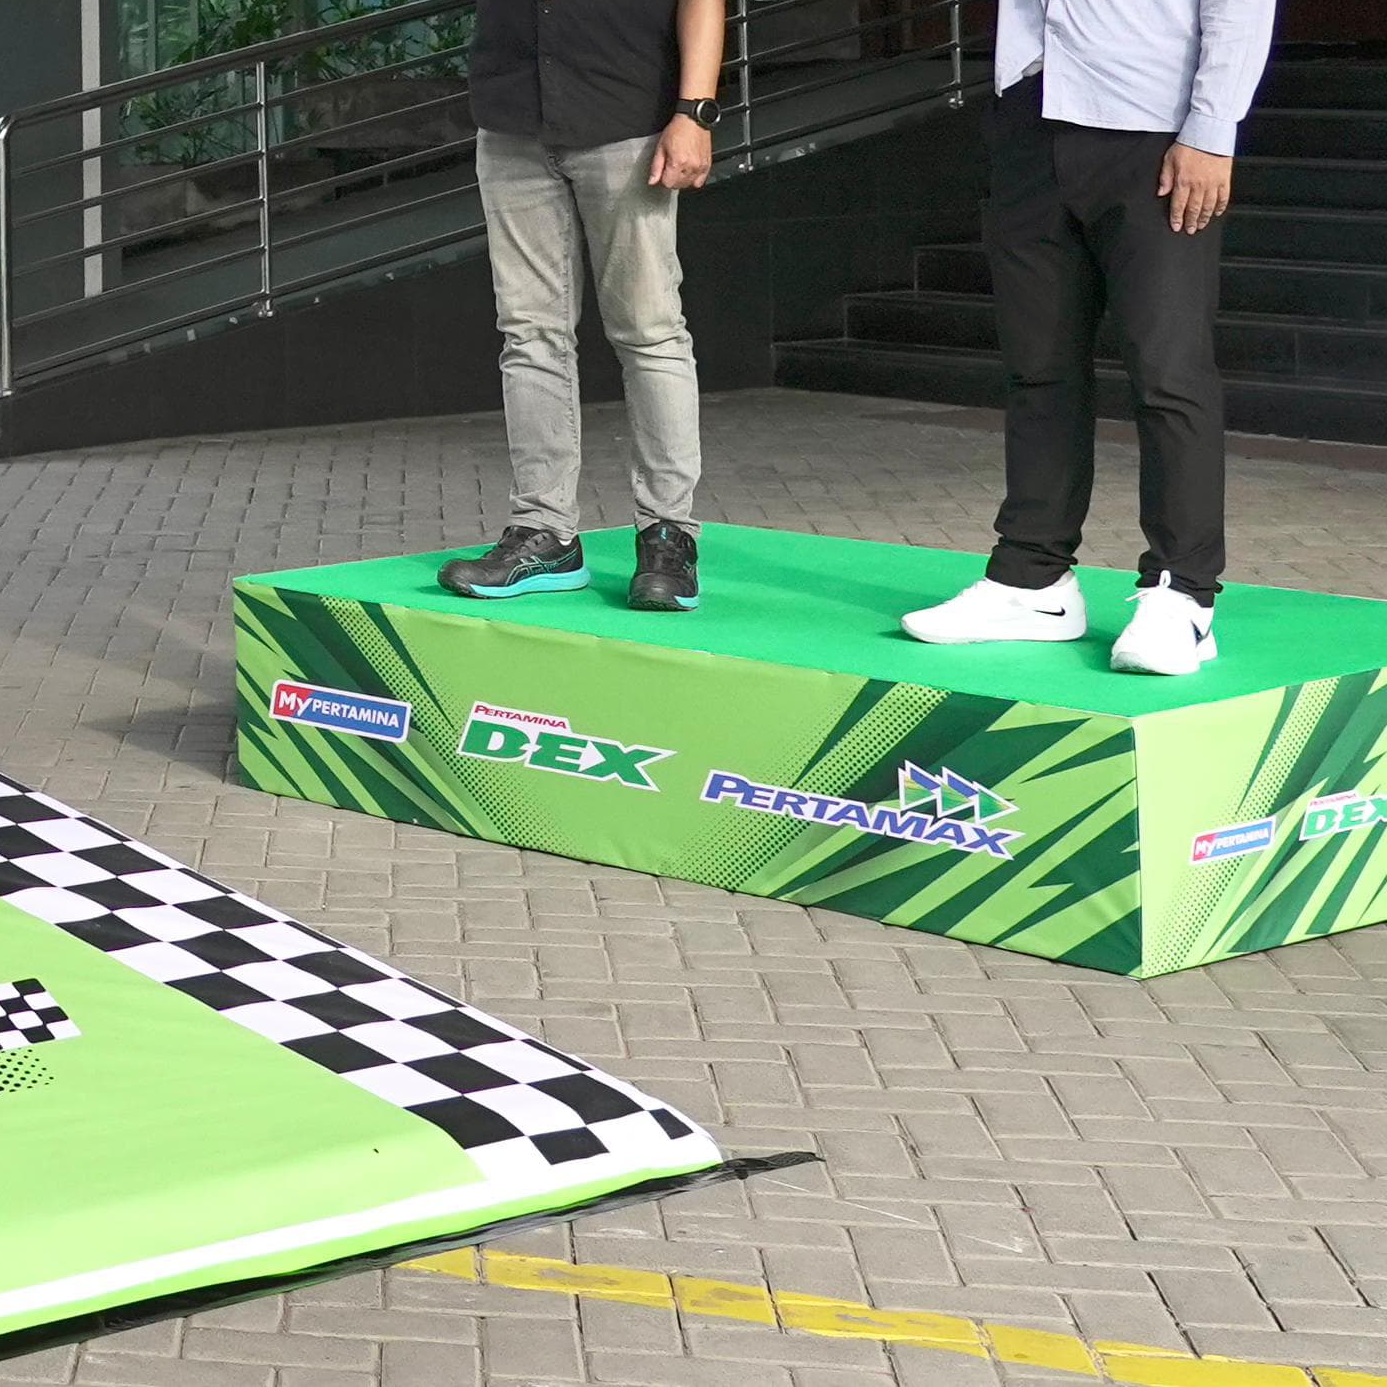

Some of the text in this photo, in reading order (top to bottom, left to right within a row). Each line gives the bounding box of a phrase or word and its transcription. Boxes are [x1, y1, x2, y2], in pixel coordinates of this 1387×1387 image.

[474, 704, 567, 730] PERTAMINA
[461, 719, 665, 787] DEX
[705, 771, 1020, 858] PERTAMAX
